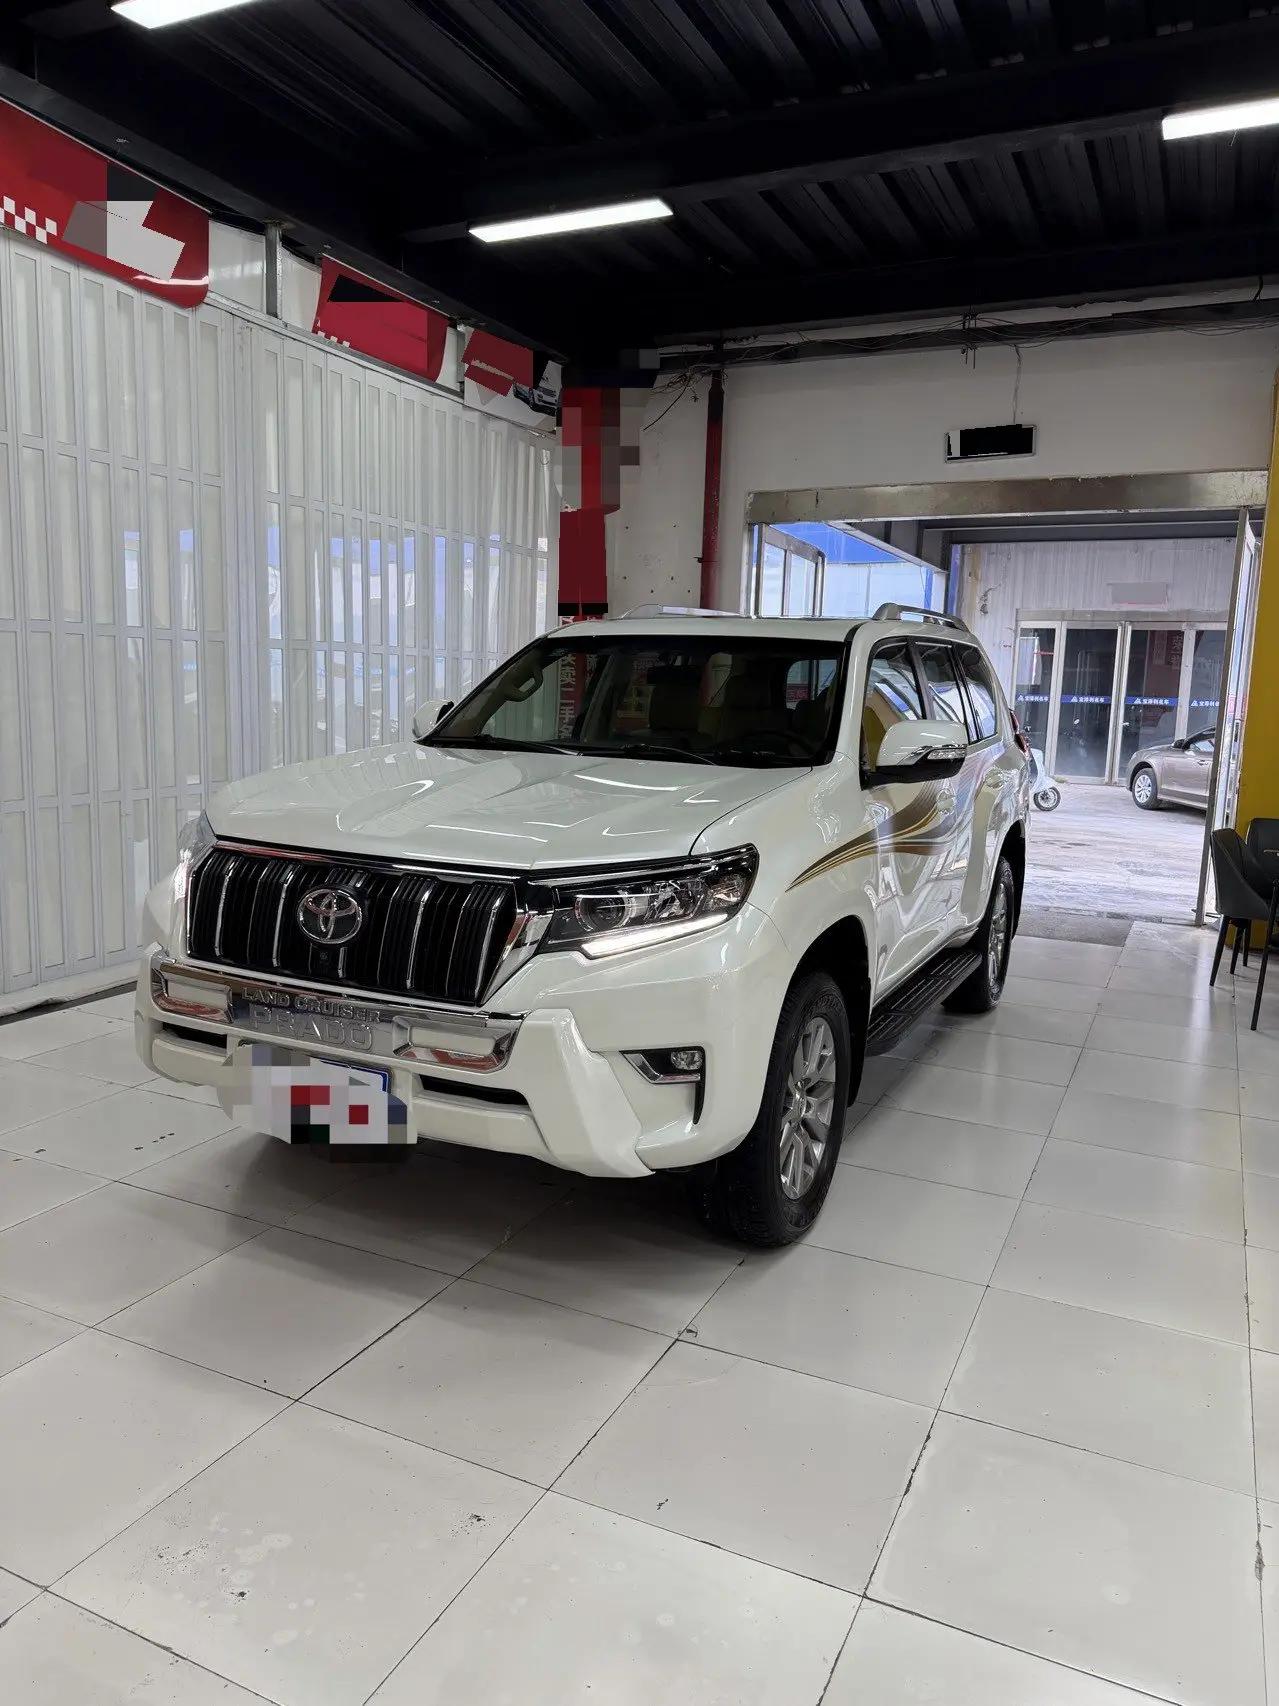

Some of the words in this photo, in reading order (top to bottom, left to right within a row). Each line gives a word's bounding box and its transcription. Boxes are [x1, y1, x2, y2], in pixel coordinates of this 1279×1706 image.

[241, 986, 290, 1008] LAND
[294, 994, 382, 1024] CRUISER
[251, 1005, 373, 1051] PRADO
